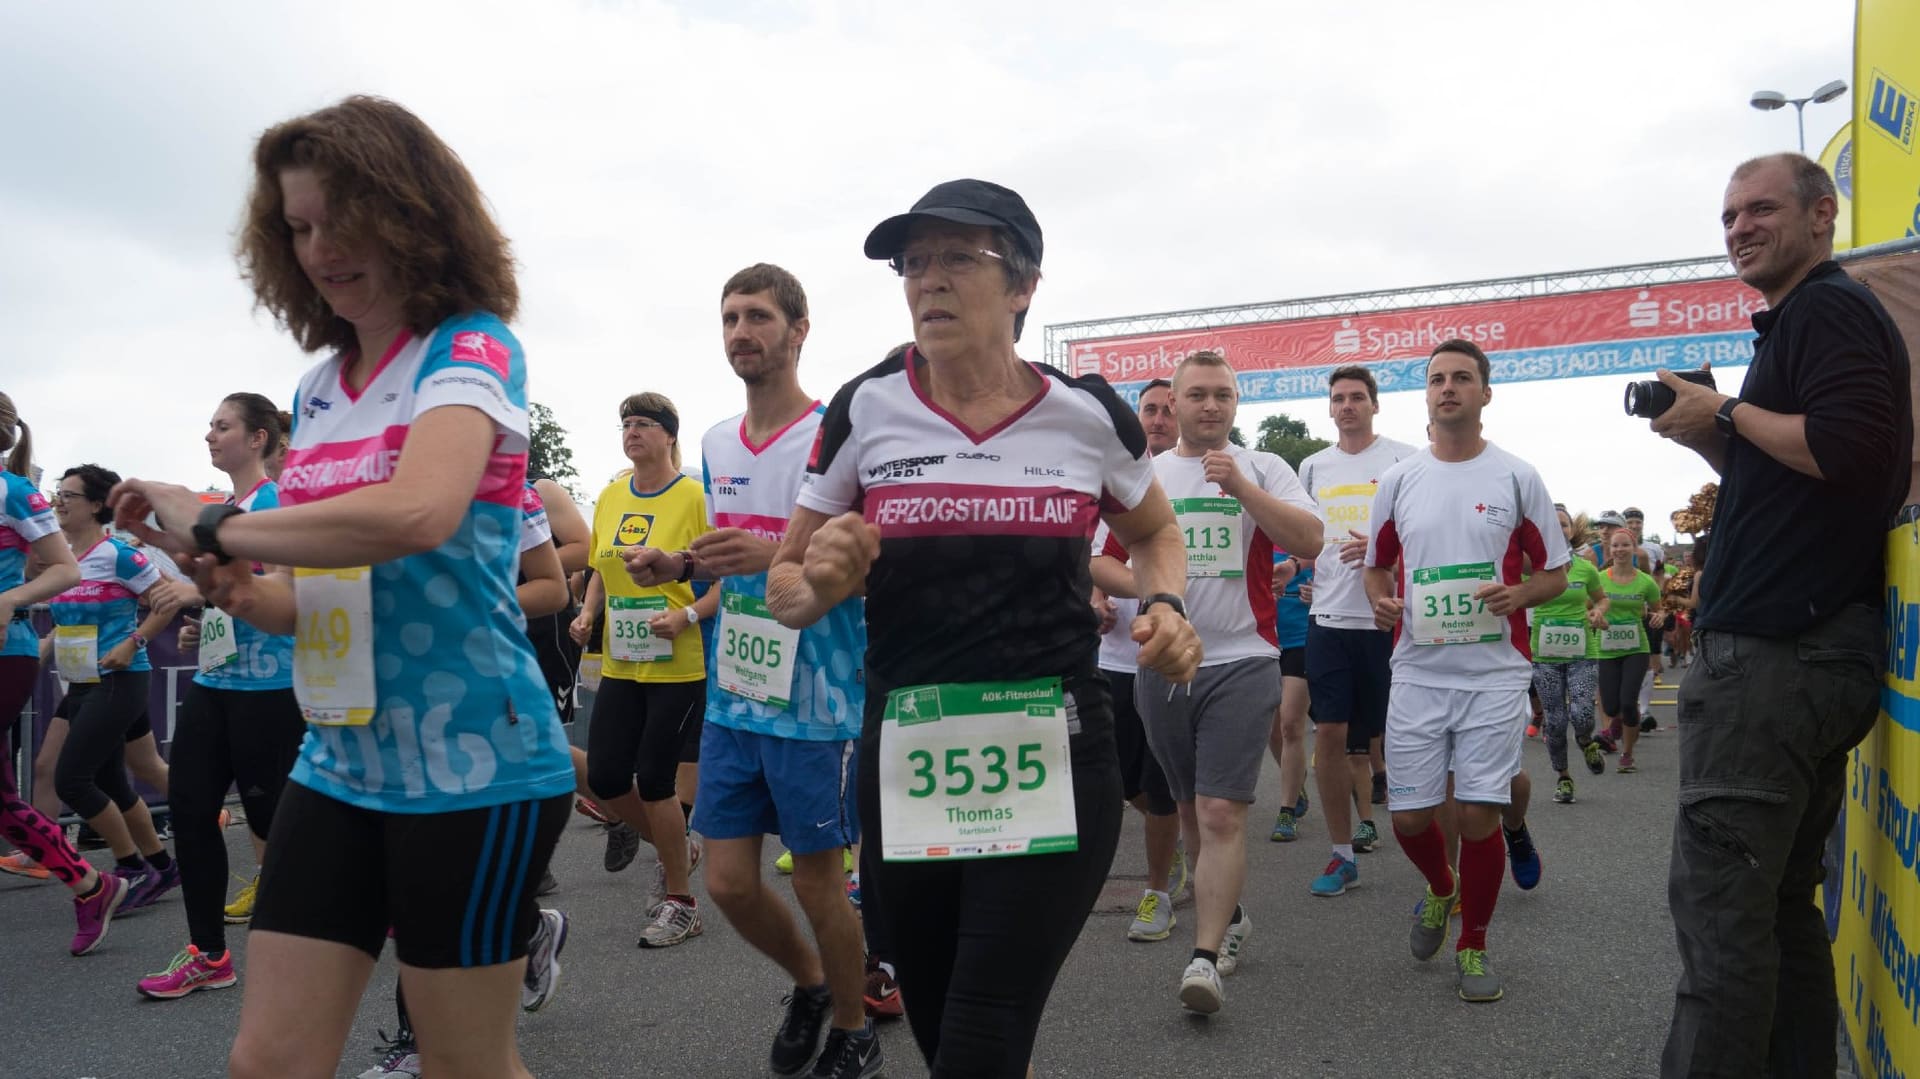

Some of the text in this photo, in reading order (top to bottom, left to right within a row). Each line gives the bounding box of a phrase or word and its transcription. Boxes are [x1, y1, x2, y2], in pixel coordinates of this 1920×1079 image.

[1902, 101, 1916, 145] EDEKA
[1366, 321, 1506, 354] Sparkasse
[1024, 466, 1065, 477] HILKE
[875, 496, 1078, 525] HERZOGSTADTLAUF
[615, 619, 654, 639] 336
[1441, 620, 1475, 629] Andreas
[1606, 629, 1635, 640] 3800
[725, 628, 782, 668] 3605
[1545, 632, 1580, 645] 3799
[734, 663, 768, 685] Wolfgang
[981, 688, 1055, 703] AOK-Fitnesslauf
[907, 743, 1047, 798] 3535
[945, 806, 1013, 824] Thomas
